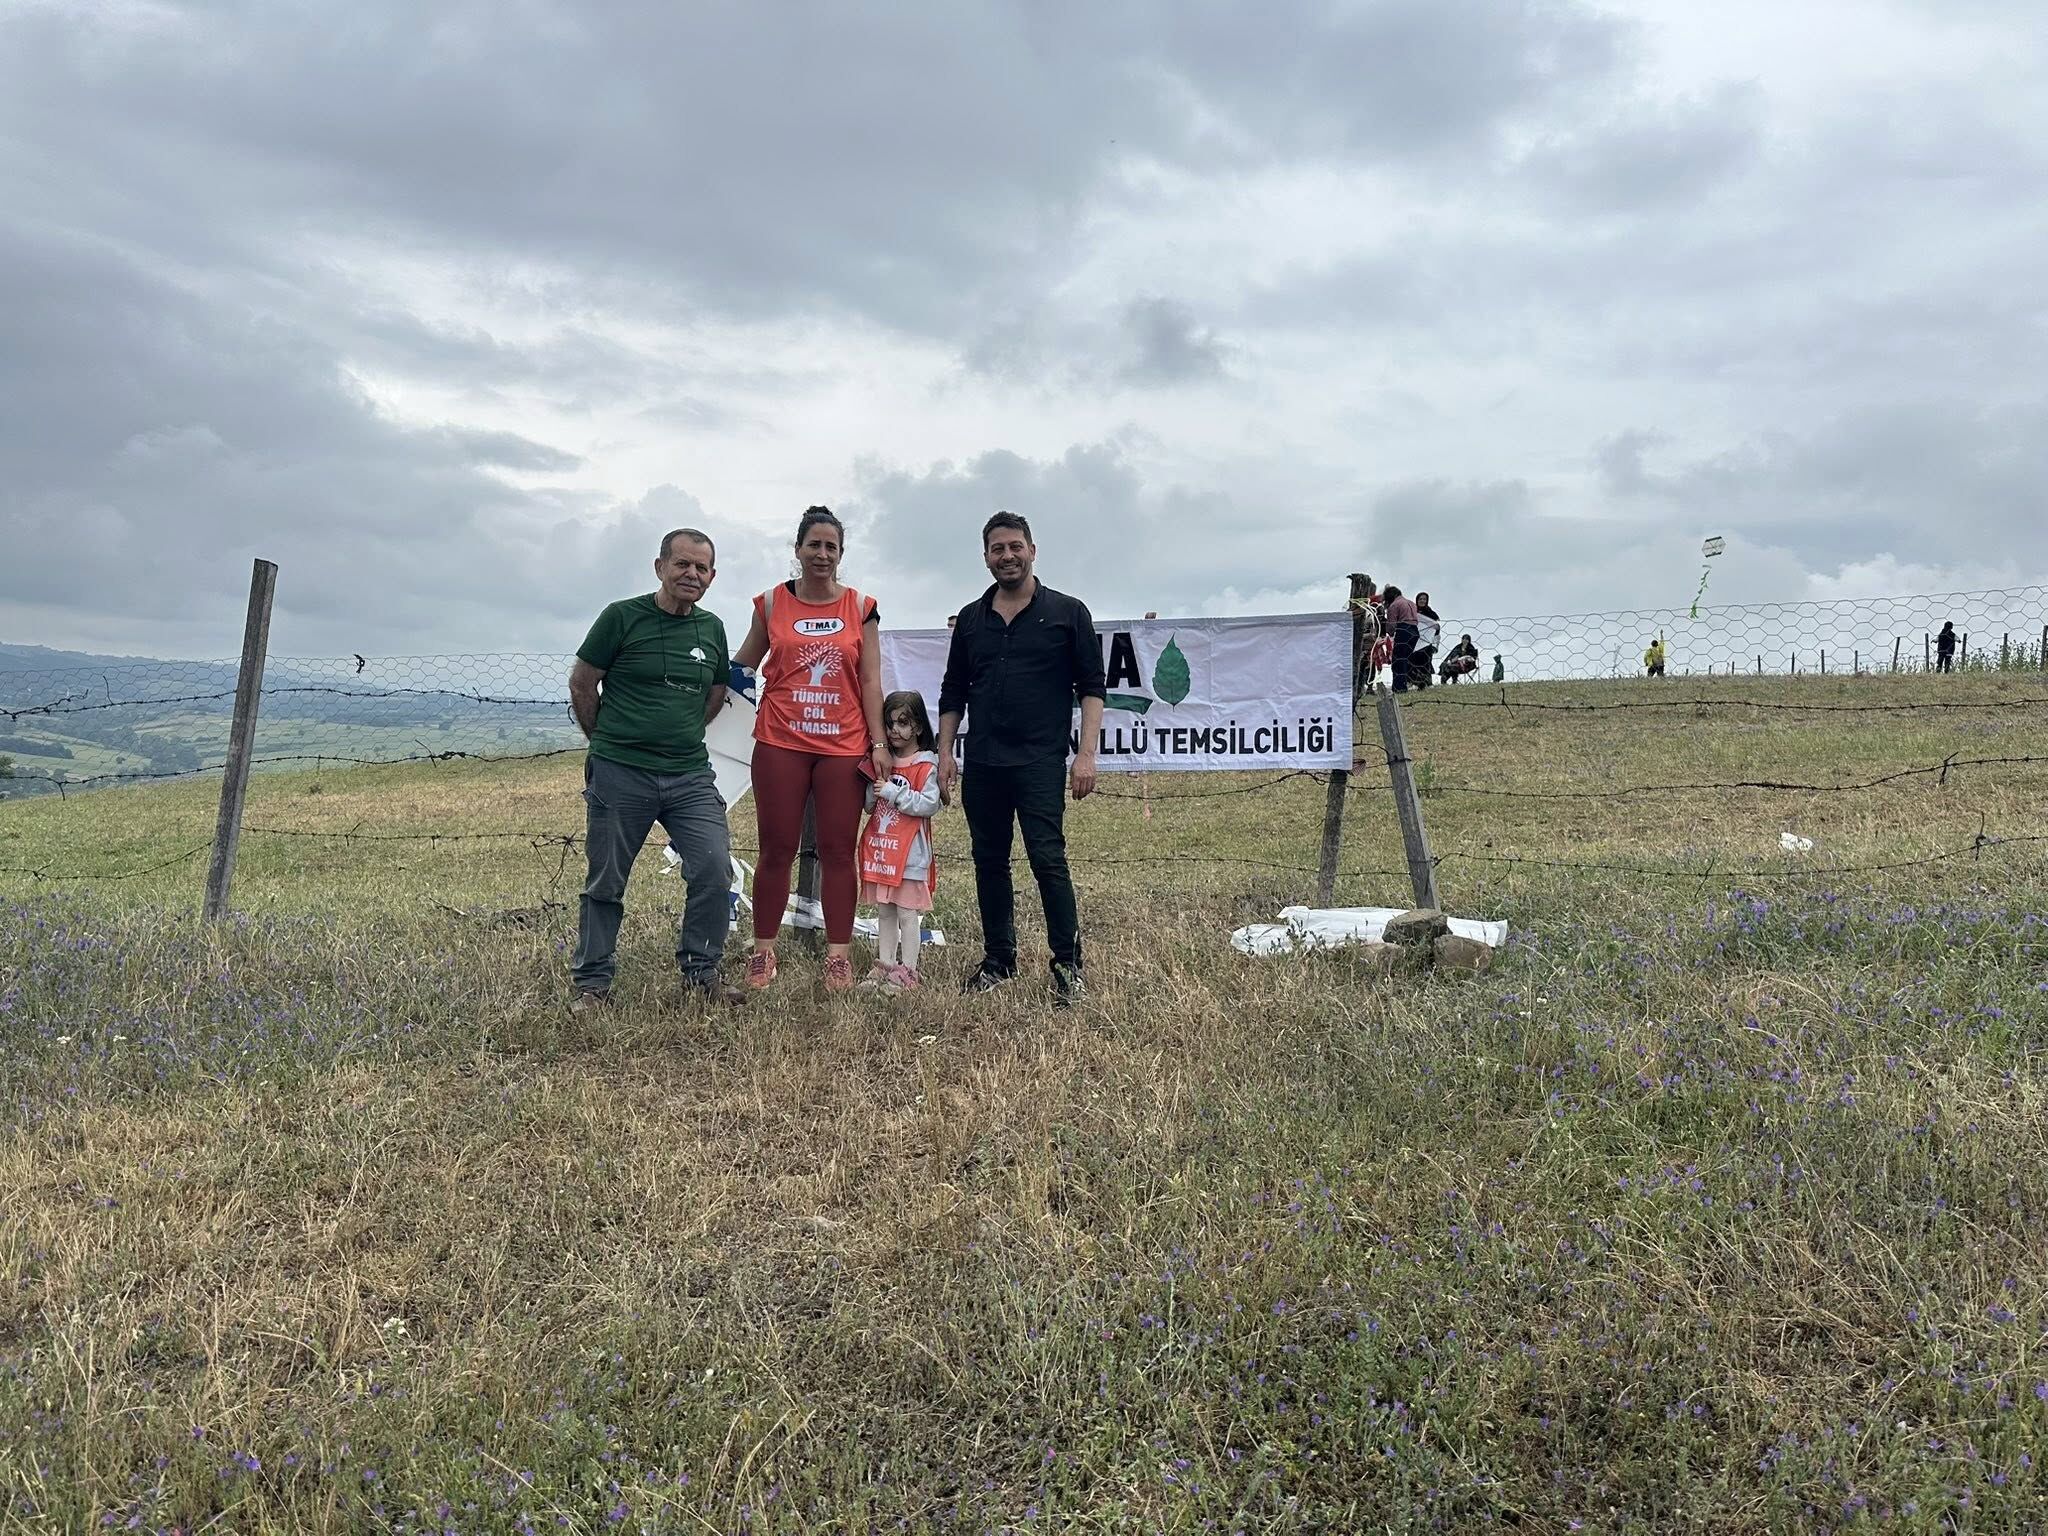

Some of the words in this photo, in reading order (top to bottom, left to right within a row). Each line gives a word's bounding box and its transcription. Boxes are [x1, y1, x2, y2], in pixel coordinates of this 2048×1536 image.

[804, 621, 830, 629] TEMA
[792, 688, 840, 705] TÜRKİYE
[803, 705, 826, 721] ÇÖL
[789, 720, 840, 735] OLMASIN
[1154, 716, 1333, 755] TEMSİLCİLİĞİ
